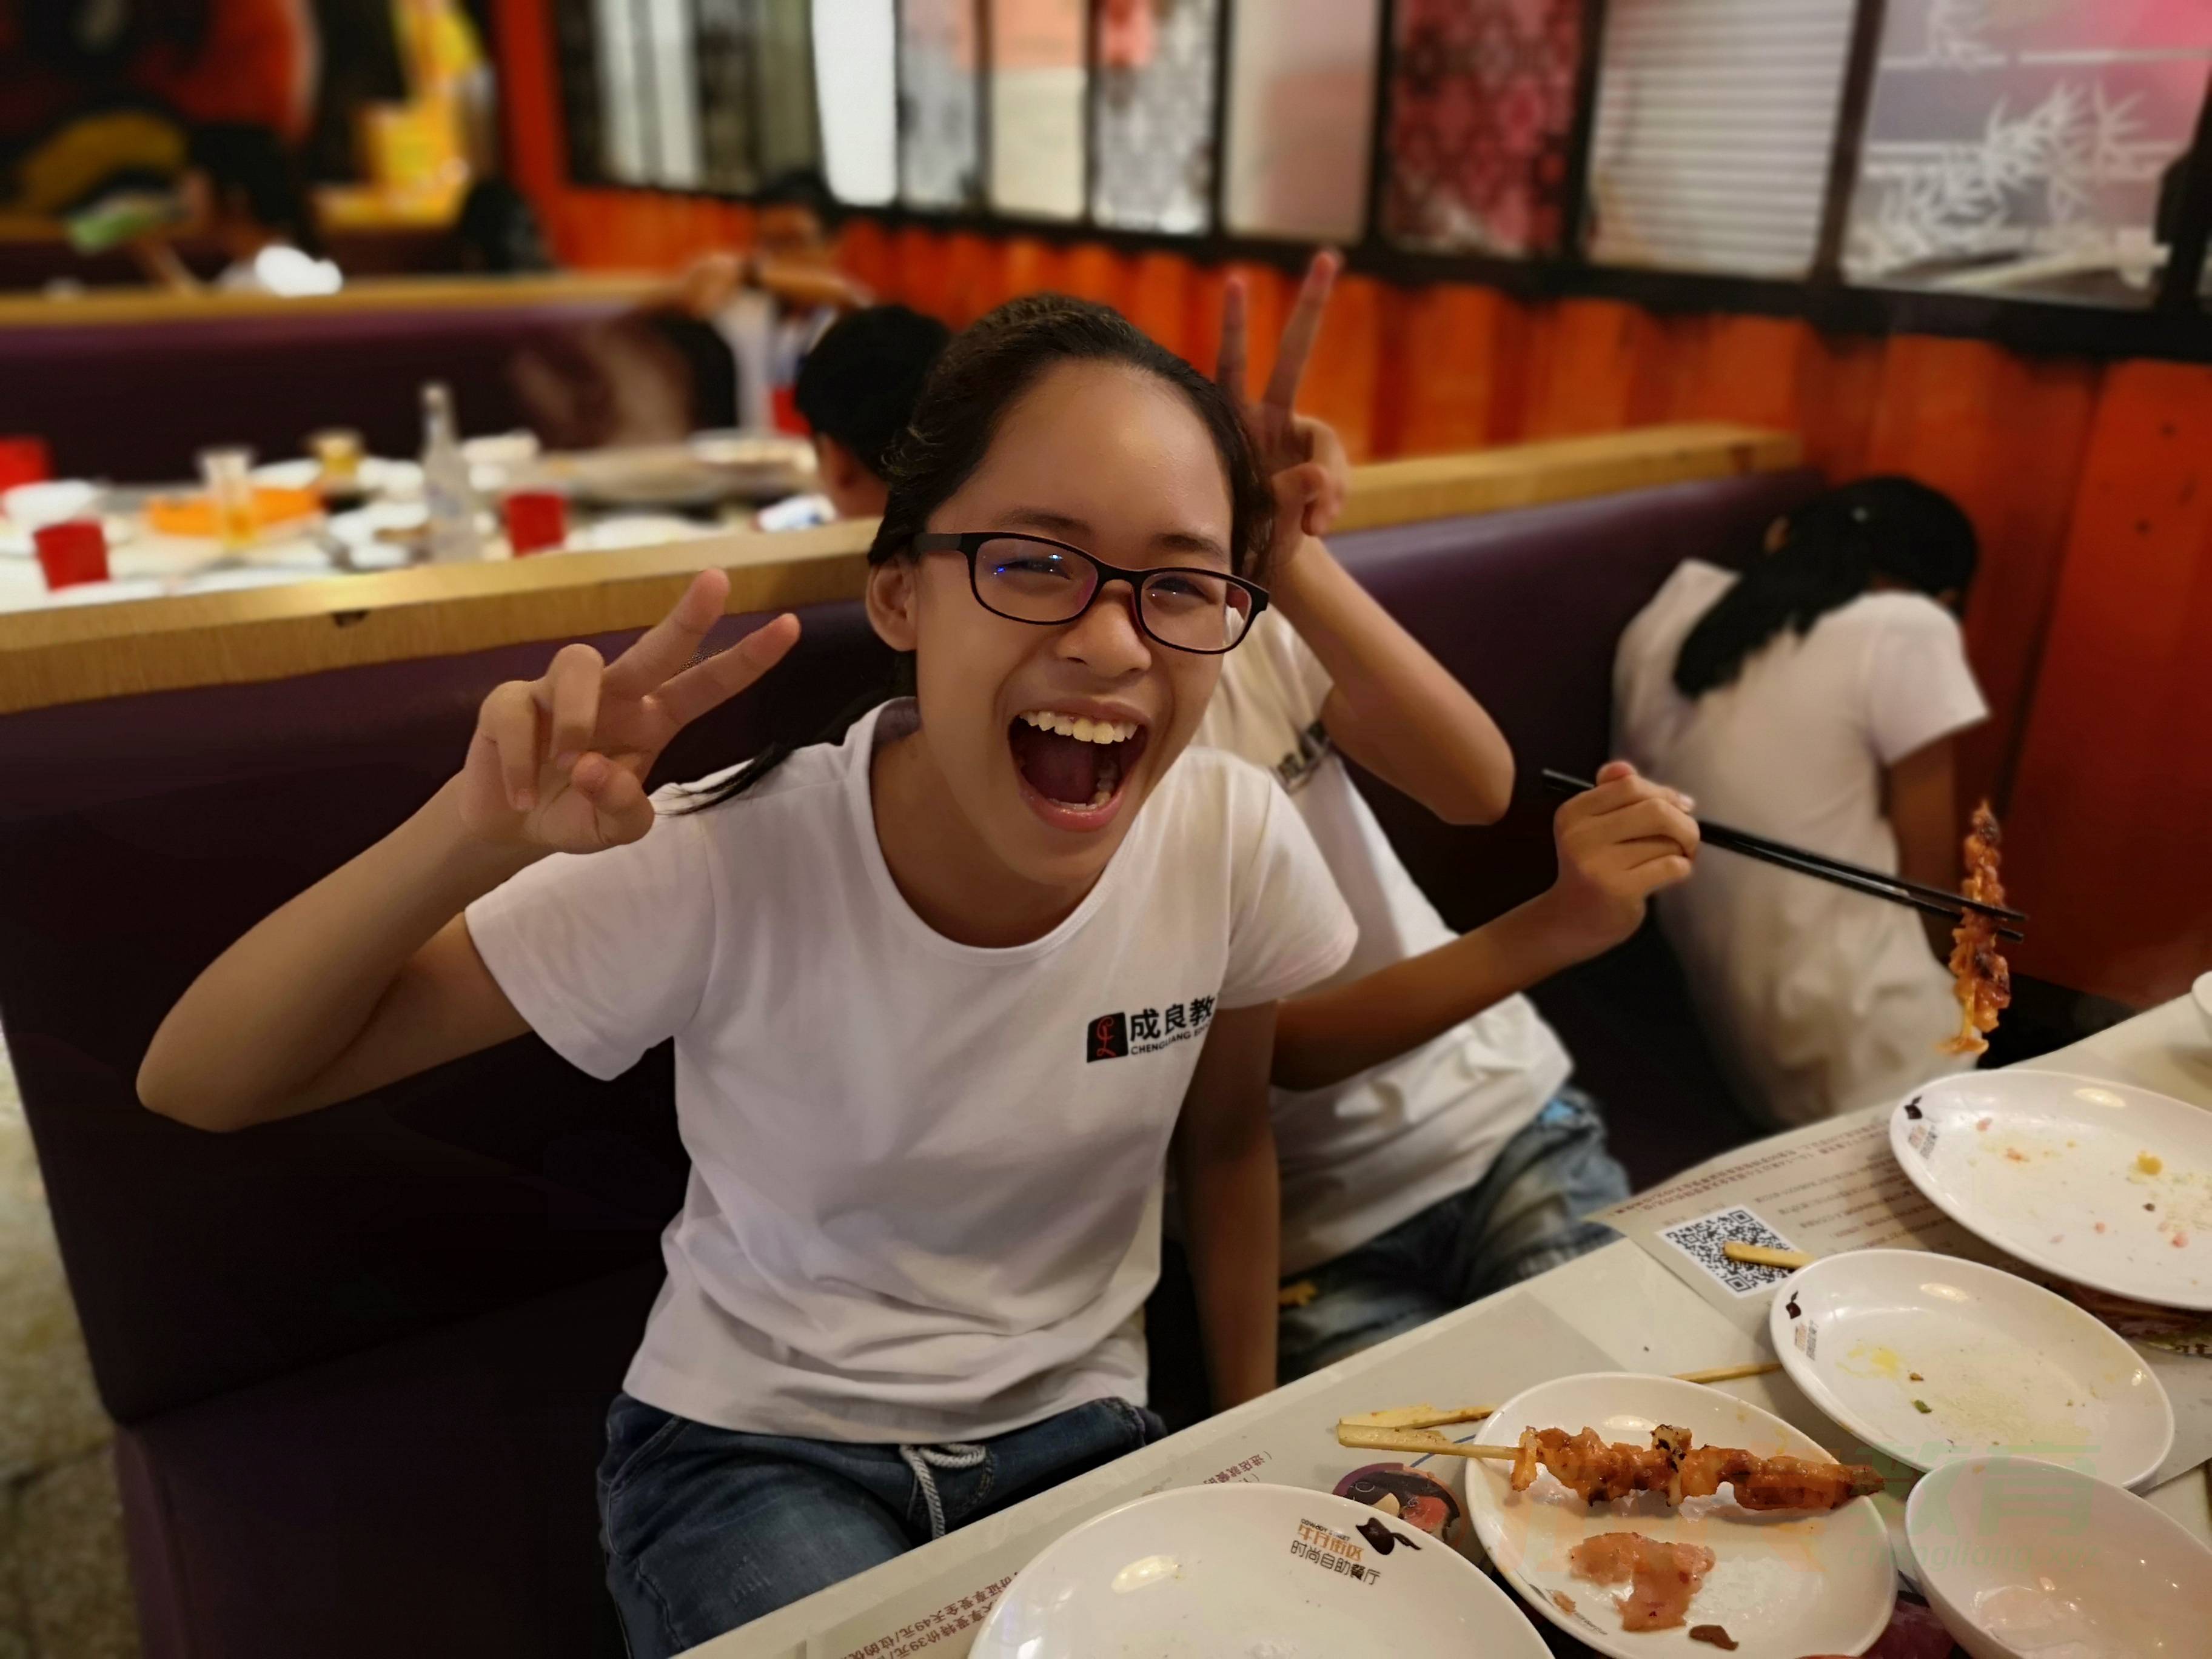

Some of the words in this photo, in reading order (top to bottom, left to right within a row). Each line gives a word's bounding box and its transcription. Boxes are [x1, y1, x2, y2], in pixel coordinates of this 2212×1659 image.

[1130, 996, 1215, 1042] 成良教
[1290, 1540, 1381, 1586] 时尚自助餐厅
